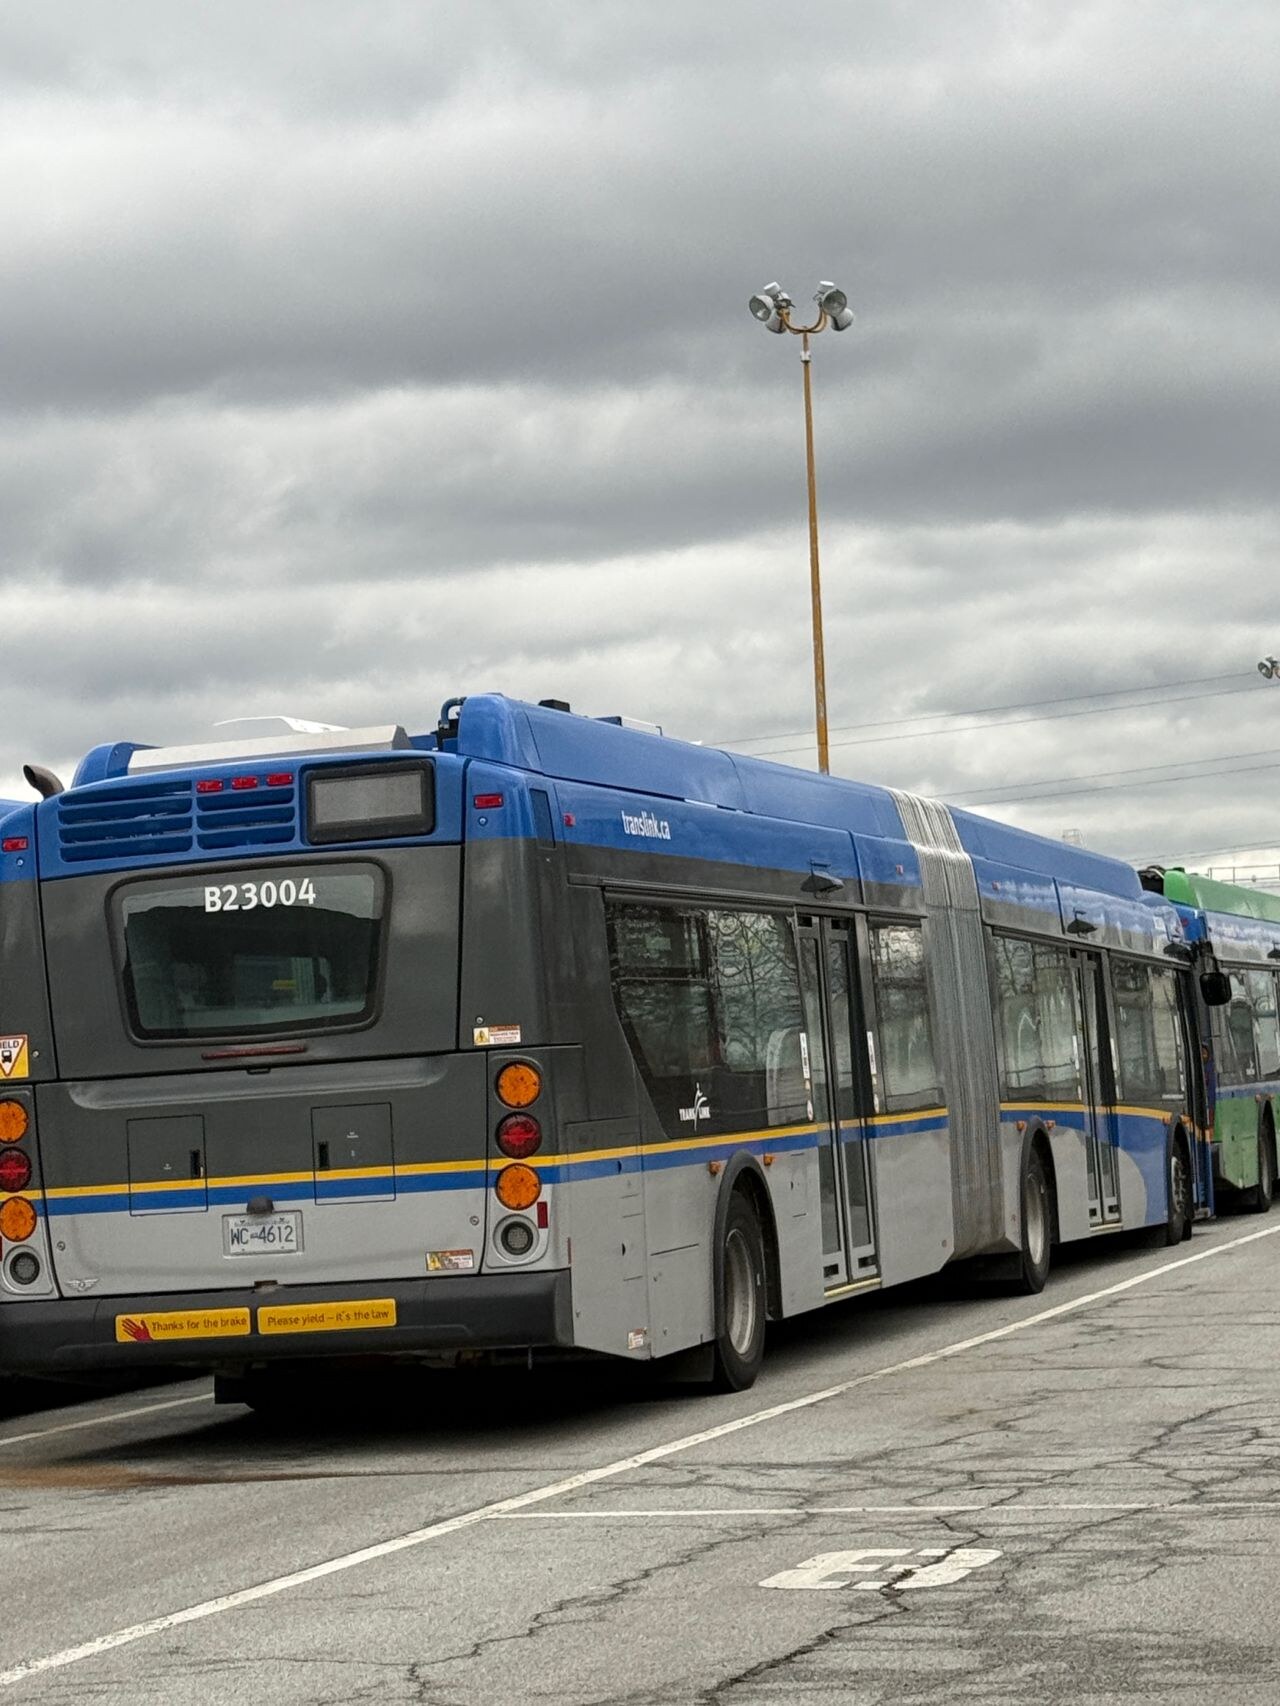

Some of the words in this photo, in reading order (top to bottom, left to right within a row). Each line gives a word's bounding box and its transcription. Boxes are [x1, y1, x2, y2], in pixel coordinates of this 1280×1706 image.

[621, 810, 671, 840] translink.ca
[204, 878, 316, 912] B23004
[0, 1040, 20, 1049] IELD
[152, 1321, 184, 1332] Thanks
[186, 1319, 200, 1330] for
[203, 1318, 218, 1329] the
[220, 1316, 247, 1328] brake
[267, 1316, 300, 1326] Please
[301, 1313, 325, 1326] yield
[336, 1310, 351, 1322] it's
[354, 1310, 369, 1320] the
[371, 1309, 389, 1320] law
